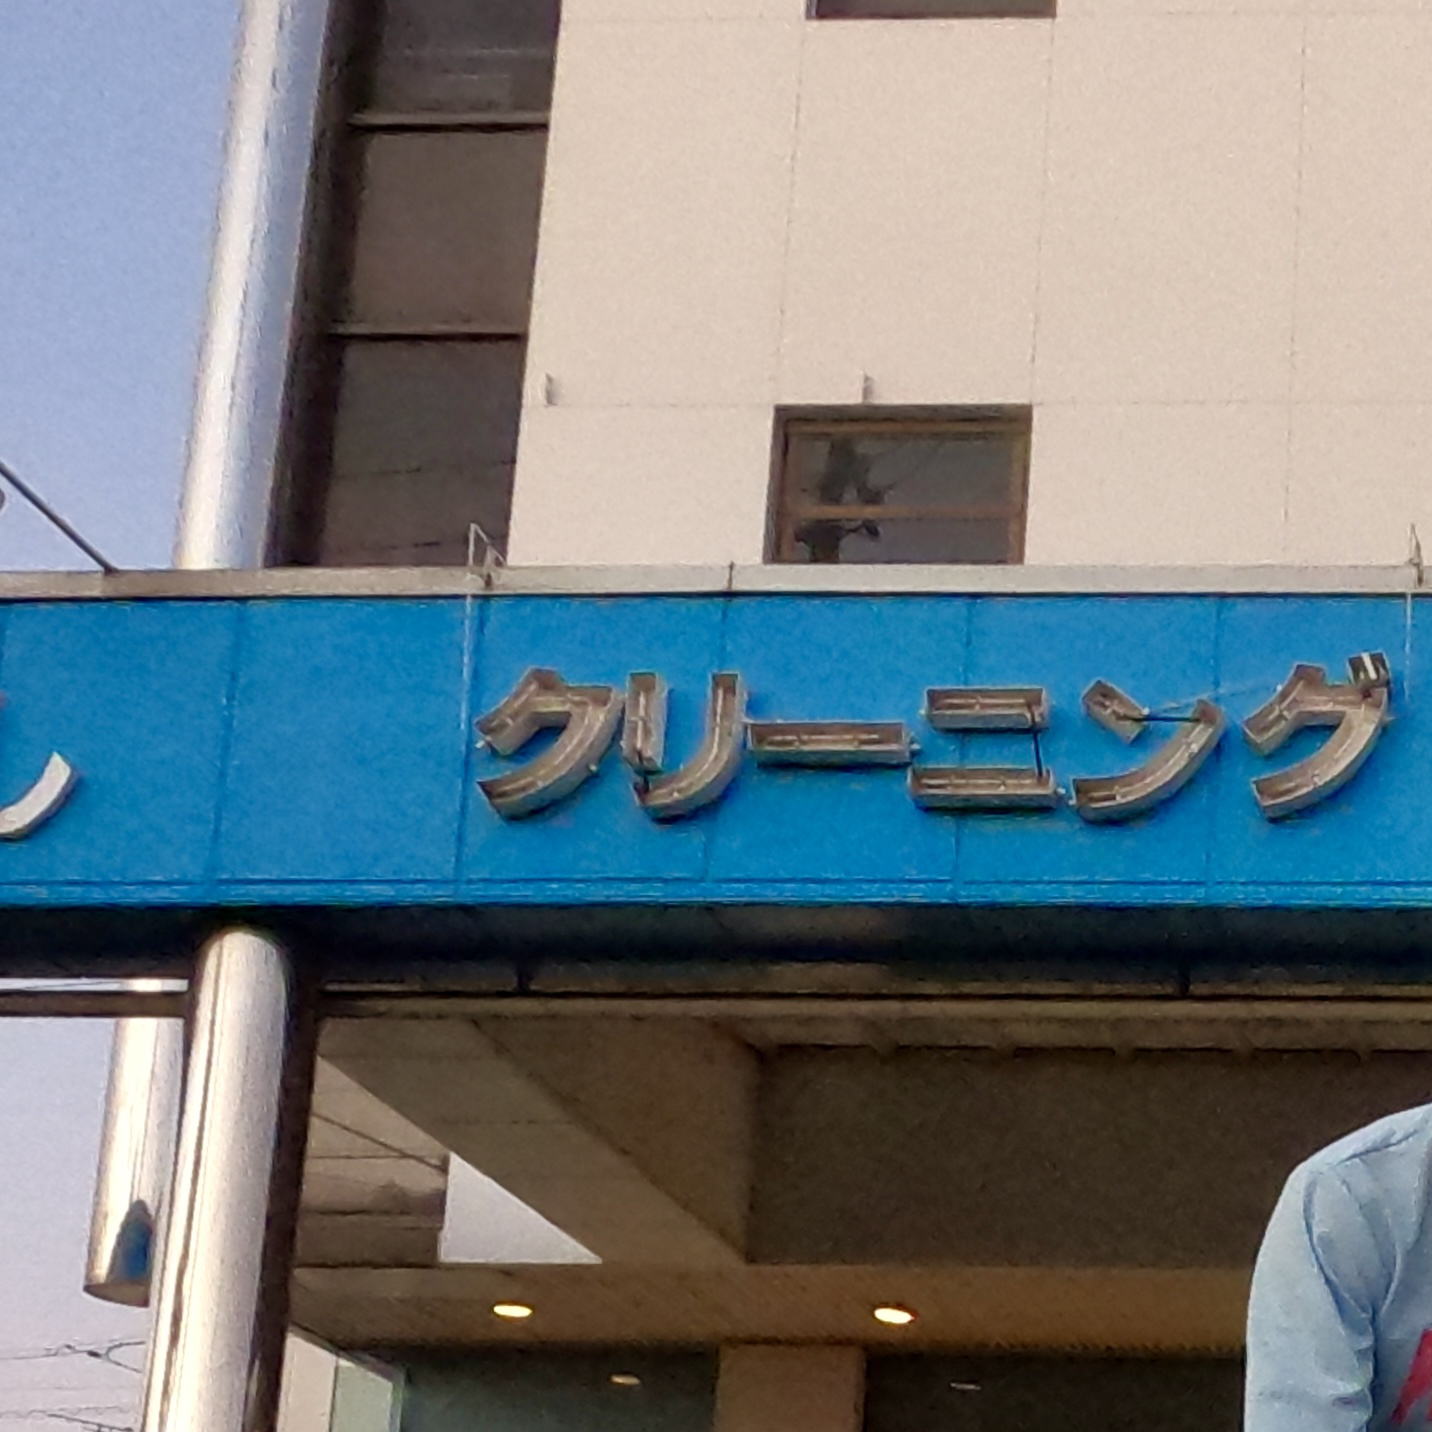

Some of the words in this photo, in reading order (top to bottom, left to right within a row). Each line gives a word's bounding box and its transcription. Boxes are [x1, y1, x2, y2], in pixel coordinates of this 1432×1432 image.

[476, 651, 1391, 822] クリーニング
